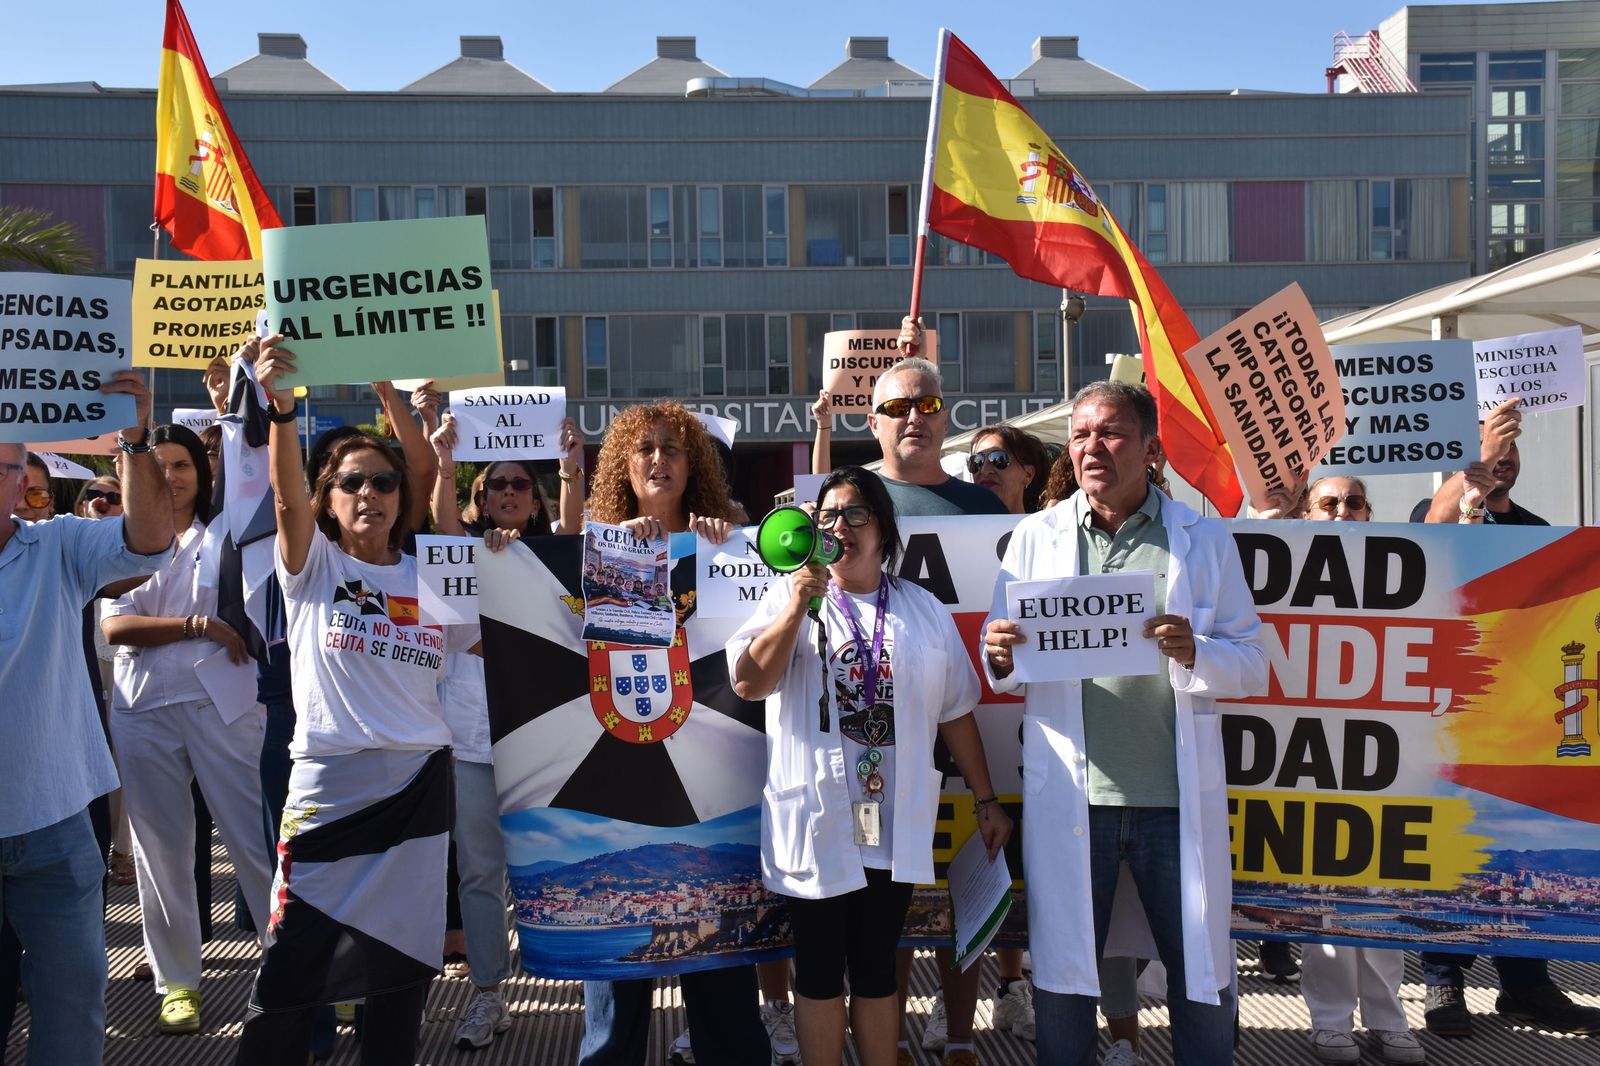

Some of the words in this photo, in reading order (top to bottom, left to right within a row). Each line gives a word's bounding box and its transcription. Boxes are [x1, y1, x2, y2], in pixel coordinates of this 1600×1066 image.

[273, 265, 483, 304] URGENCIAS
[278, 316, 323, 341] AL
[333, 305, 455, 338] LÍMITE
[149, 342, 246, 359] OLVIDAD
[848, 338, 898, 350] MENO
[1475, 345, 1558, 363] MINISTRA
[1205, 347, 1231, 382] LA
[1335, 354, 1433, 377] MENOS
[1479, 361, 1557, 379] ESCUCHA
[852, 376, 863, 388] Y
[1226, 329, 1293, 448] IMPORTAN
[1253, 321, 1320, 462] CATEGORÍAS
[1496, 383, 1507, 394] A
[1510, 379, 1542, 393] LOS
[464, 392, 551, 407] SANIDAD
[1477, 392, 1568, 411] SANARIOS
[0, 402, 106, 424] DADAS
[180, 419, 213, 427] SANID
[495, 413, 522, 428] AL
[1317, 400, 1335, 443] LAS
[1345, 416, 1360, 435] Y
[1370, 413, 1430, 435] MAS
[473, 432, 545, 450] LÍMITE
[54, 461, 69, 470] YA
[1018, 593, 1145, 619] EUROPE
[329, 612, 367, 634] CEUTA
[372, 622, 390, 638] NO
[395, 627, 411, 642] SE
[325, 631, 365, 653] CEUTA
[370, 640, 388, 658] SE
[1036, 627, 1128, 652] HELP!
[1262, 622, 1452, 715] NDE,
